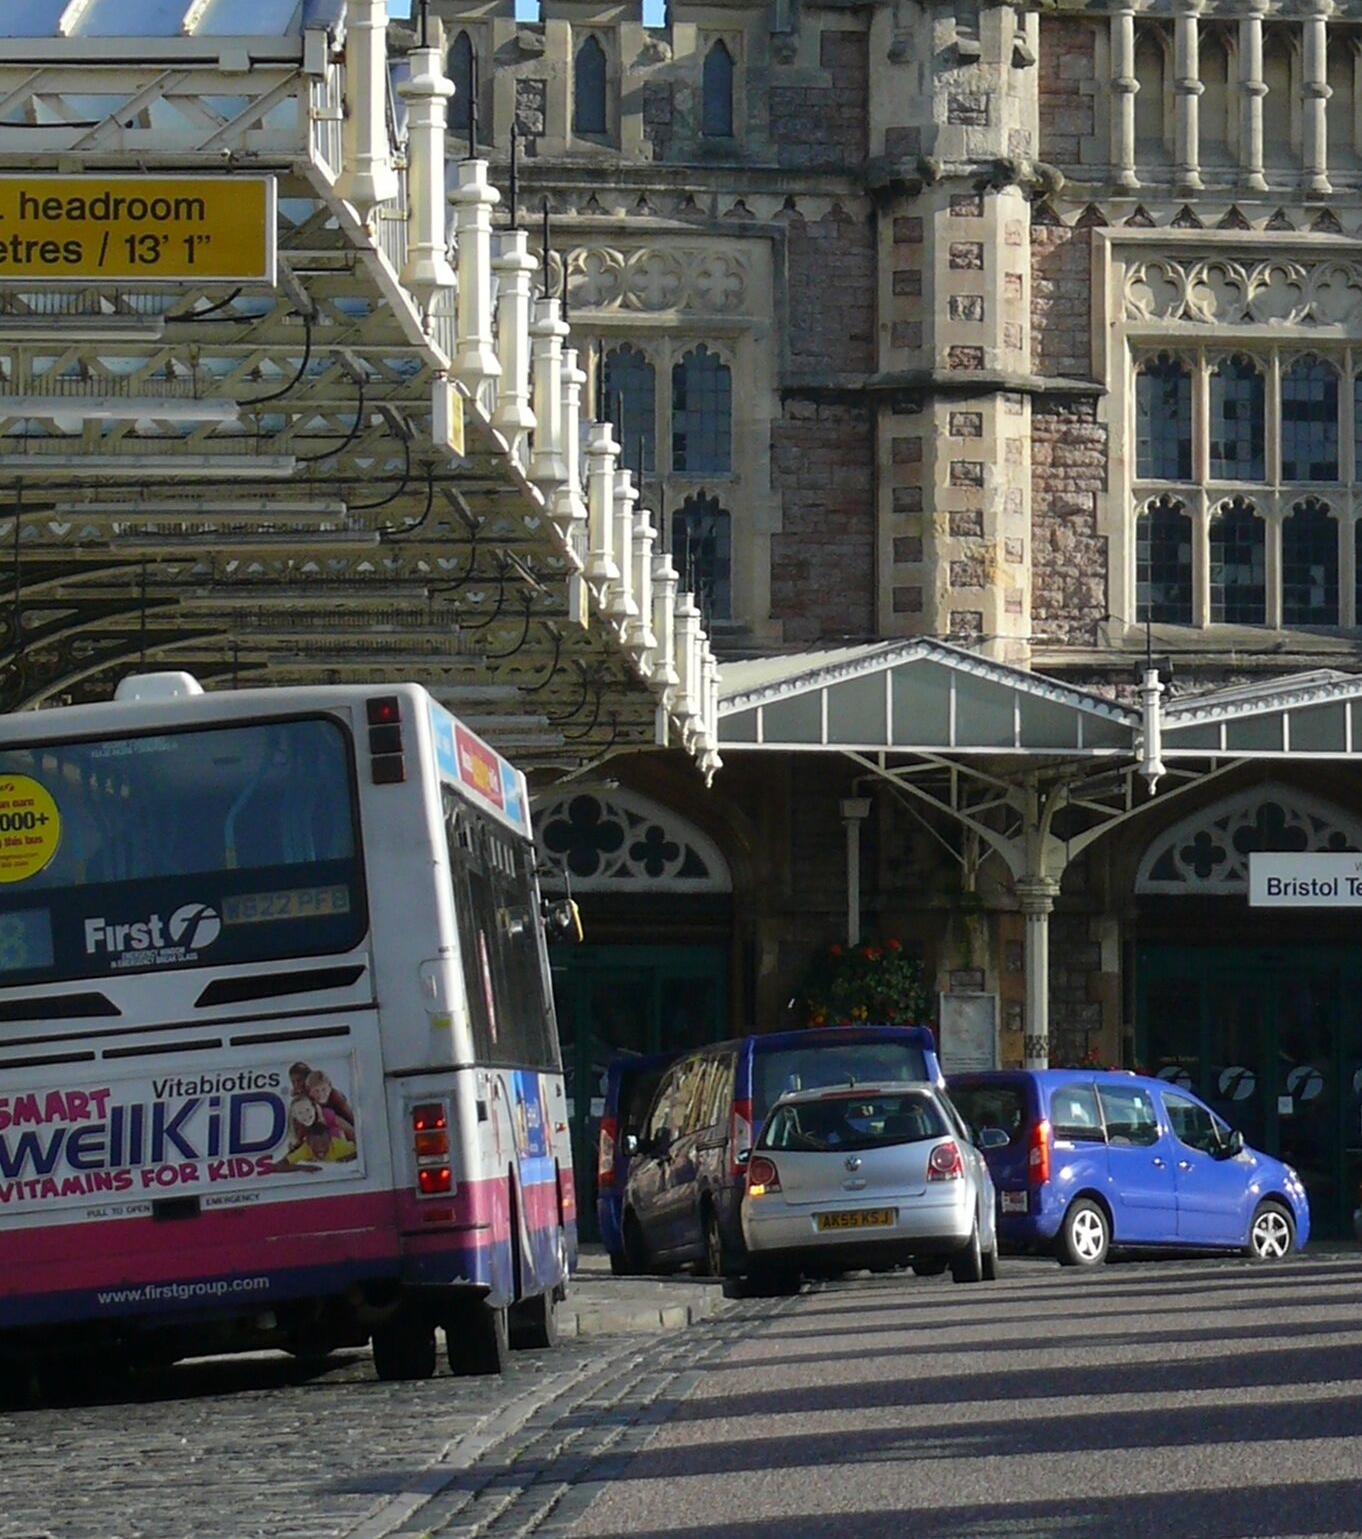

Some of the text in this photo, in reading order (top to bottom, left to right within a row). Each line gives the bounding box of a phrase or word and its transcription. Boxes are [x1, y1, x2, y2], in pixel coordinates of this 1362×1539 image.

[20, 191, 205, 221] headroom
[1266, 877, 1338, 897] Bristol
[84, 914, 165, 953] First
[152, 1070, 281, 1099] Vitabiotics
[0, 1087, 110, 1130] SMART
[0, 1153, 275, 1203] VITAMINS FOR KIDS
[87, 1205, 150, 1218] PULL TO OPEN
[206, 1192, 260, 1206] EMERGENCY
[97, 1276, 270, 1304] www.firstgroup.com
